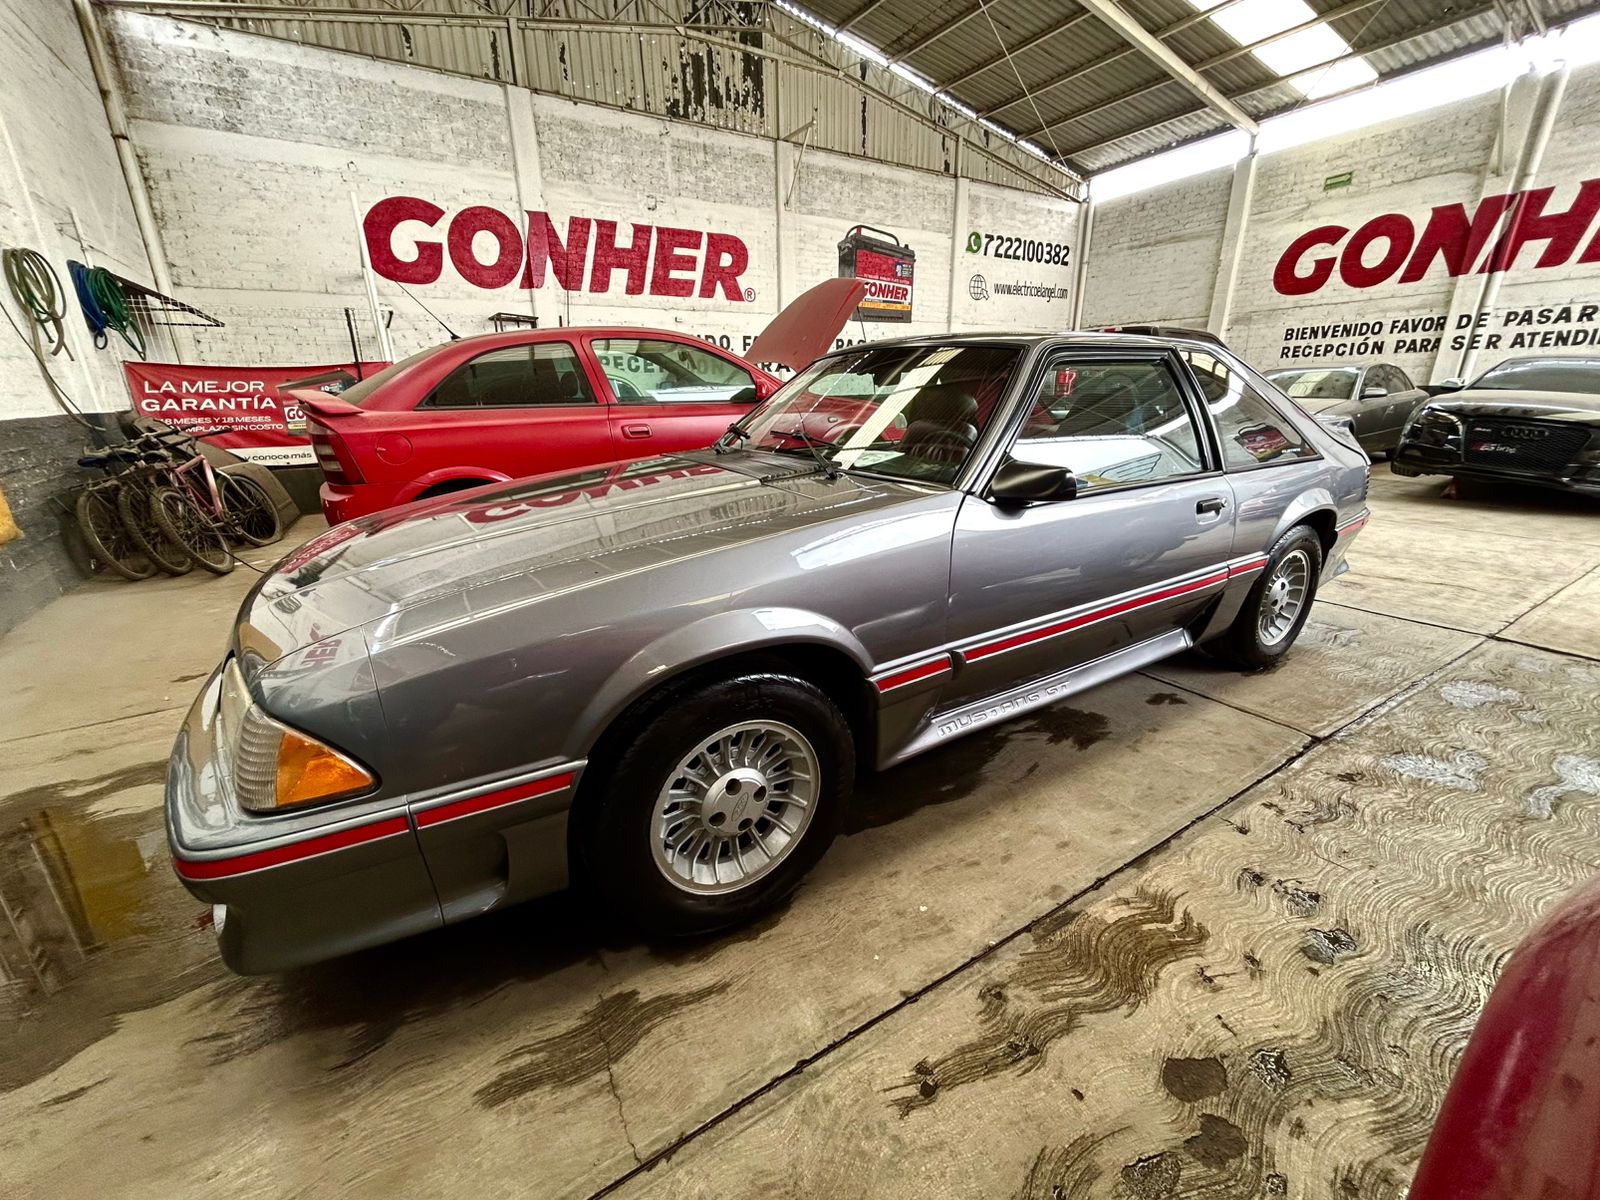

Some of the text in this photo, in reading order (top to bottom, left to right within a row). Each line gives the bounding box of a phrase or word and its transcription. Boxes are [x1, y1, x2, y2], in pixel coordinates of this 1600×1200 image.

[1272, 178, 1600, 296] GONH
[983, 233, 1070, 267] 7222100382
[993, 279, 1069, 303] www.electricoelangel.com
[1284, 304, 1599, 342] BIENVENIDO FAVOR DE PASAR
[1280, 327, 1600, 359] RECEPCIÓN PARA SER ATENDI
[144, 380, 265, 394] LA MEJOR
[141, 393, 277, 412] GARANTÍA
[173, 417, 212, 426] MESES
[221, 416, 235, 424] 18
[235, 415, 272, 423] MESES
[232, 424, 249, 432] SIN
[249, 423, 284, 432] COSTO
[290, 451, 312, 459] más
[937, 692, 1040, 738] MUSTANG
